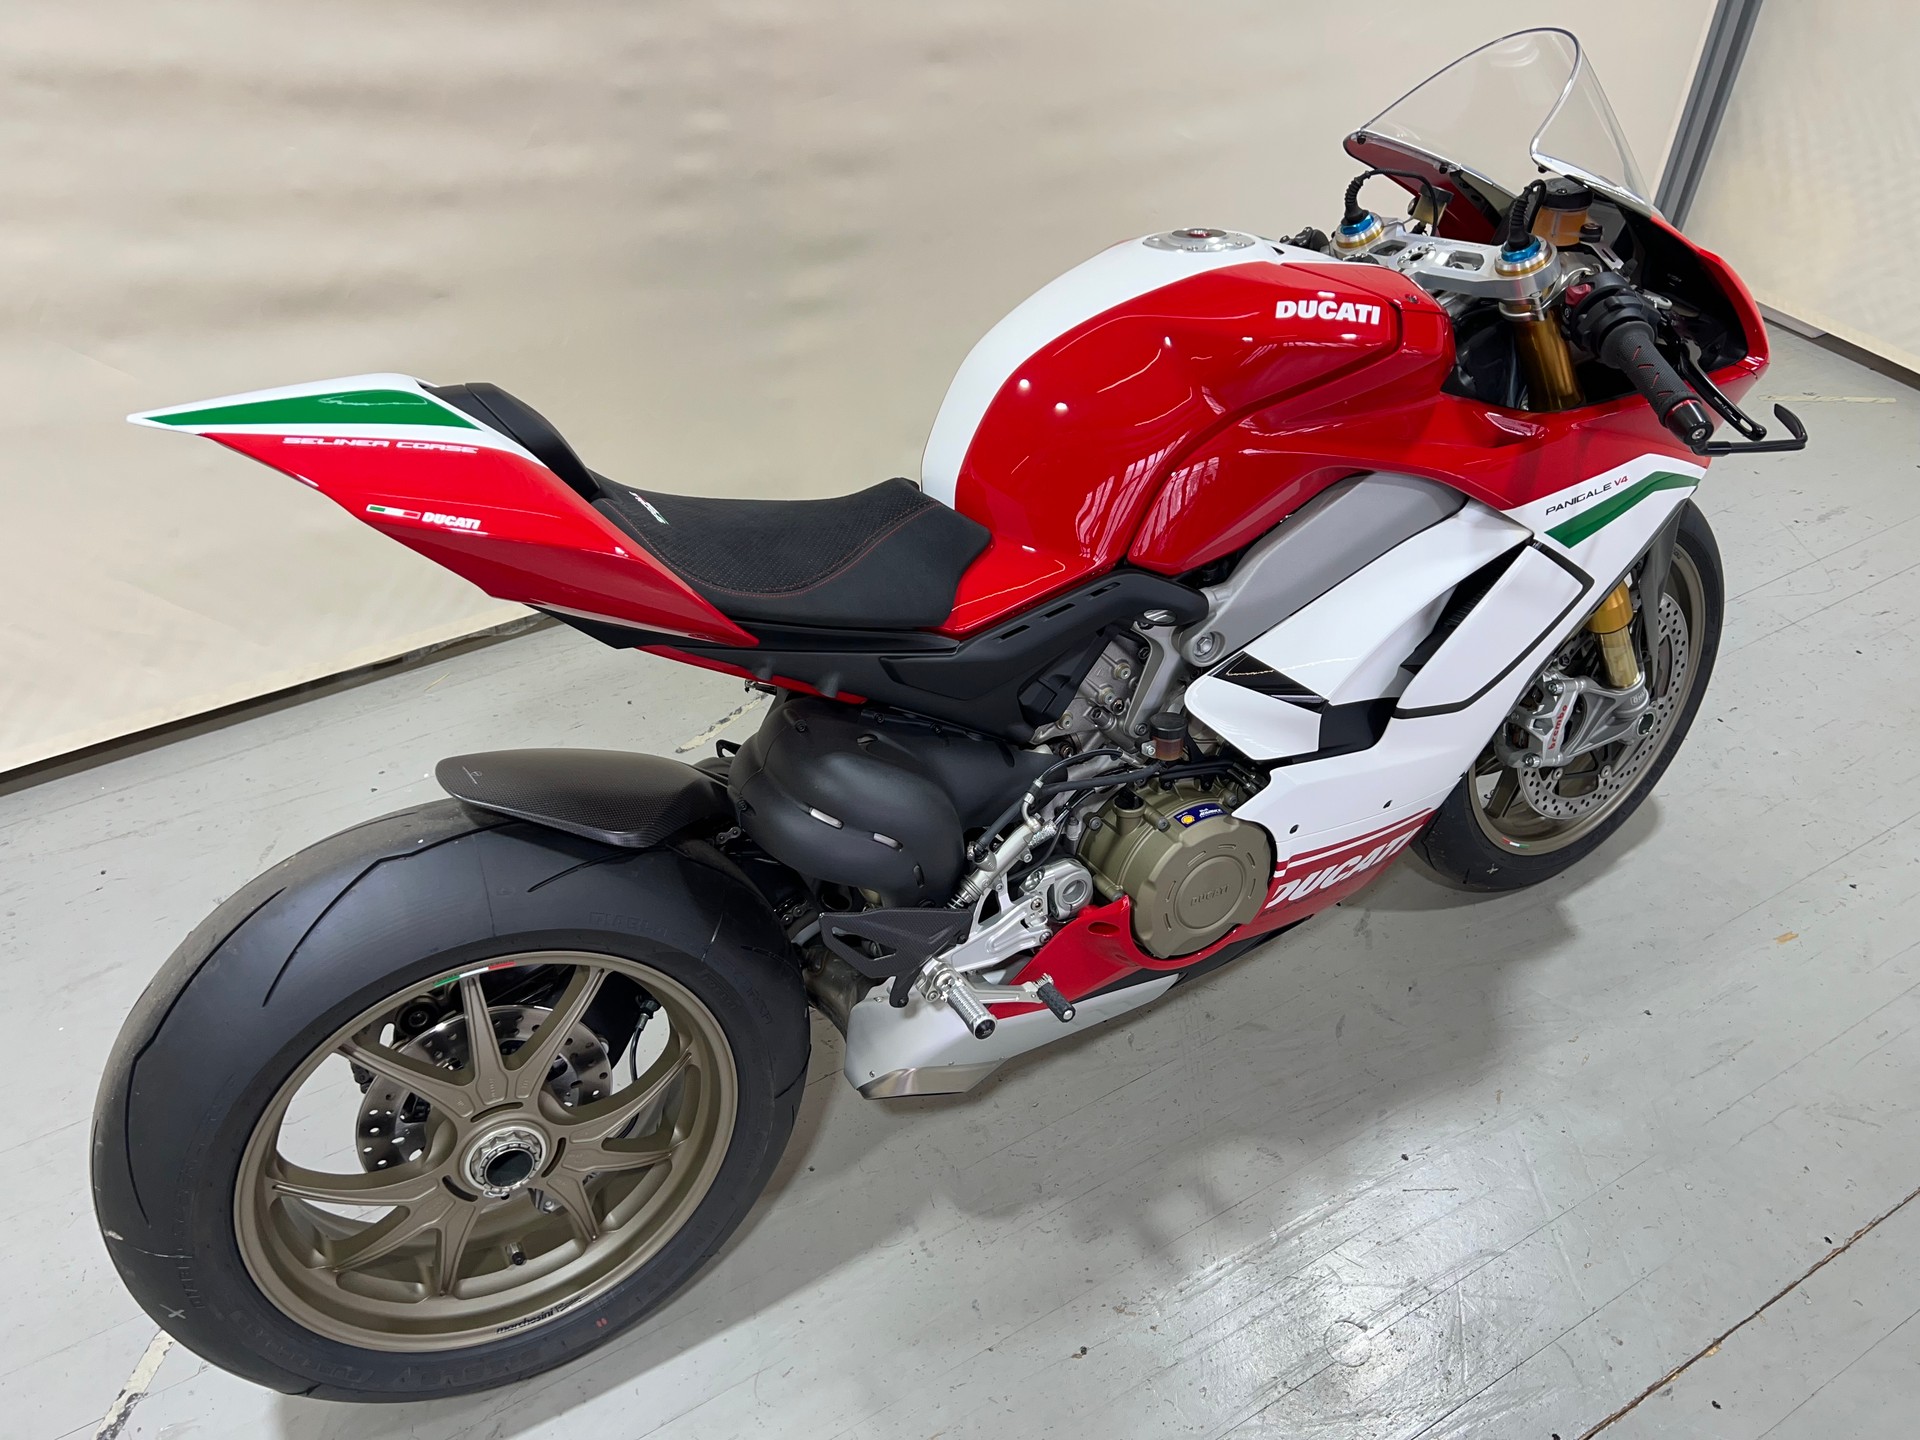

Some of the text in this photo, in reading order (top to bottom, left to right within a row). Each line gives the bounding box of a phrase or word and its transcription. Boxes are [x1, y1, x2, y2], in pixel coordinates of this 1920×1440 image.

[1275, 300, 1381, 326] DUCATI
[396, 441, 479, 455] CORSE
[1545, 475, 1629, 516] PANIGALE V4
[422, 511, 482, 531] DUCATI
[1547, 704, 1569, 750] brembo
[1265, 824, 1424, 910] DUCATI
